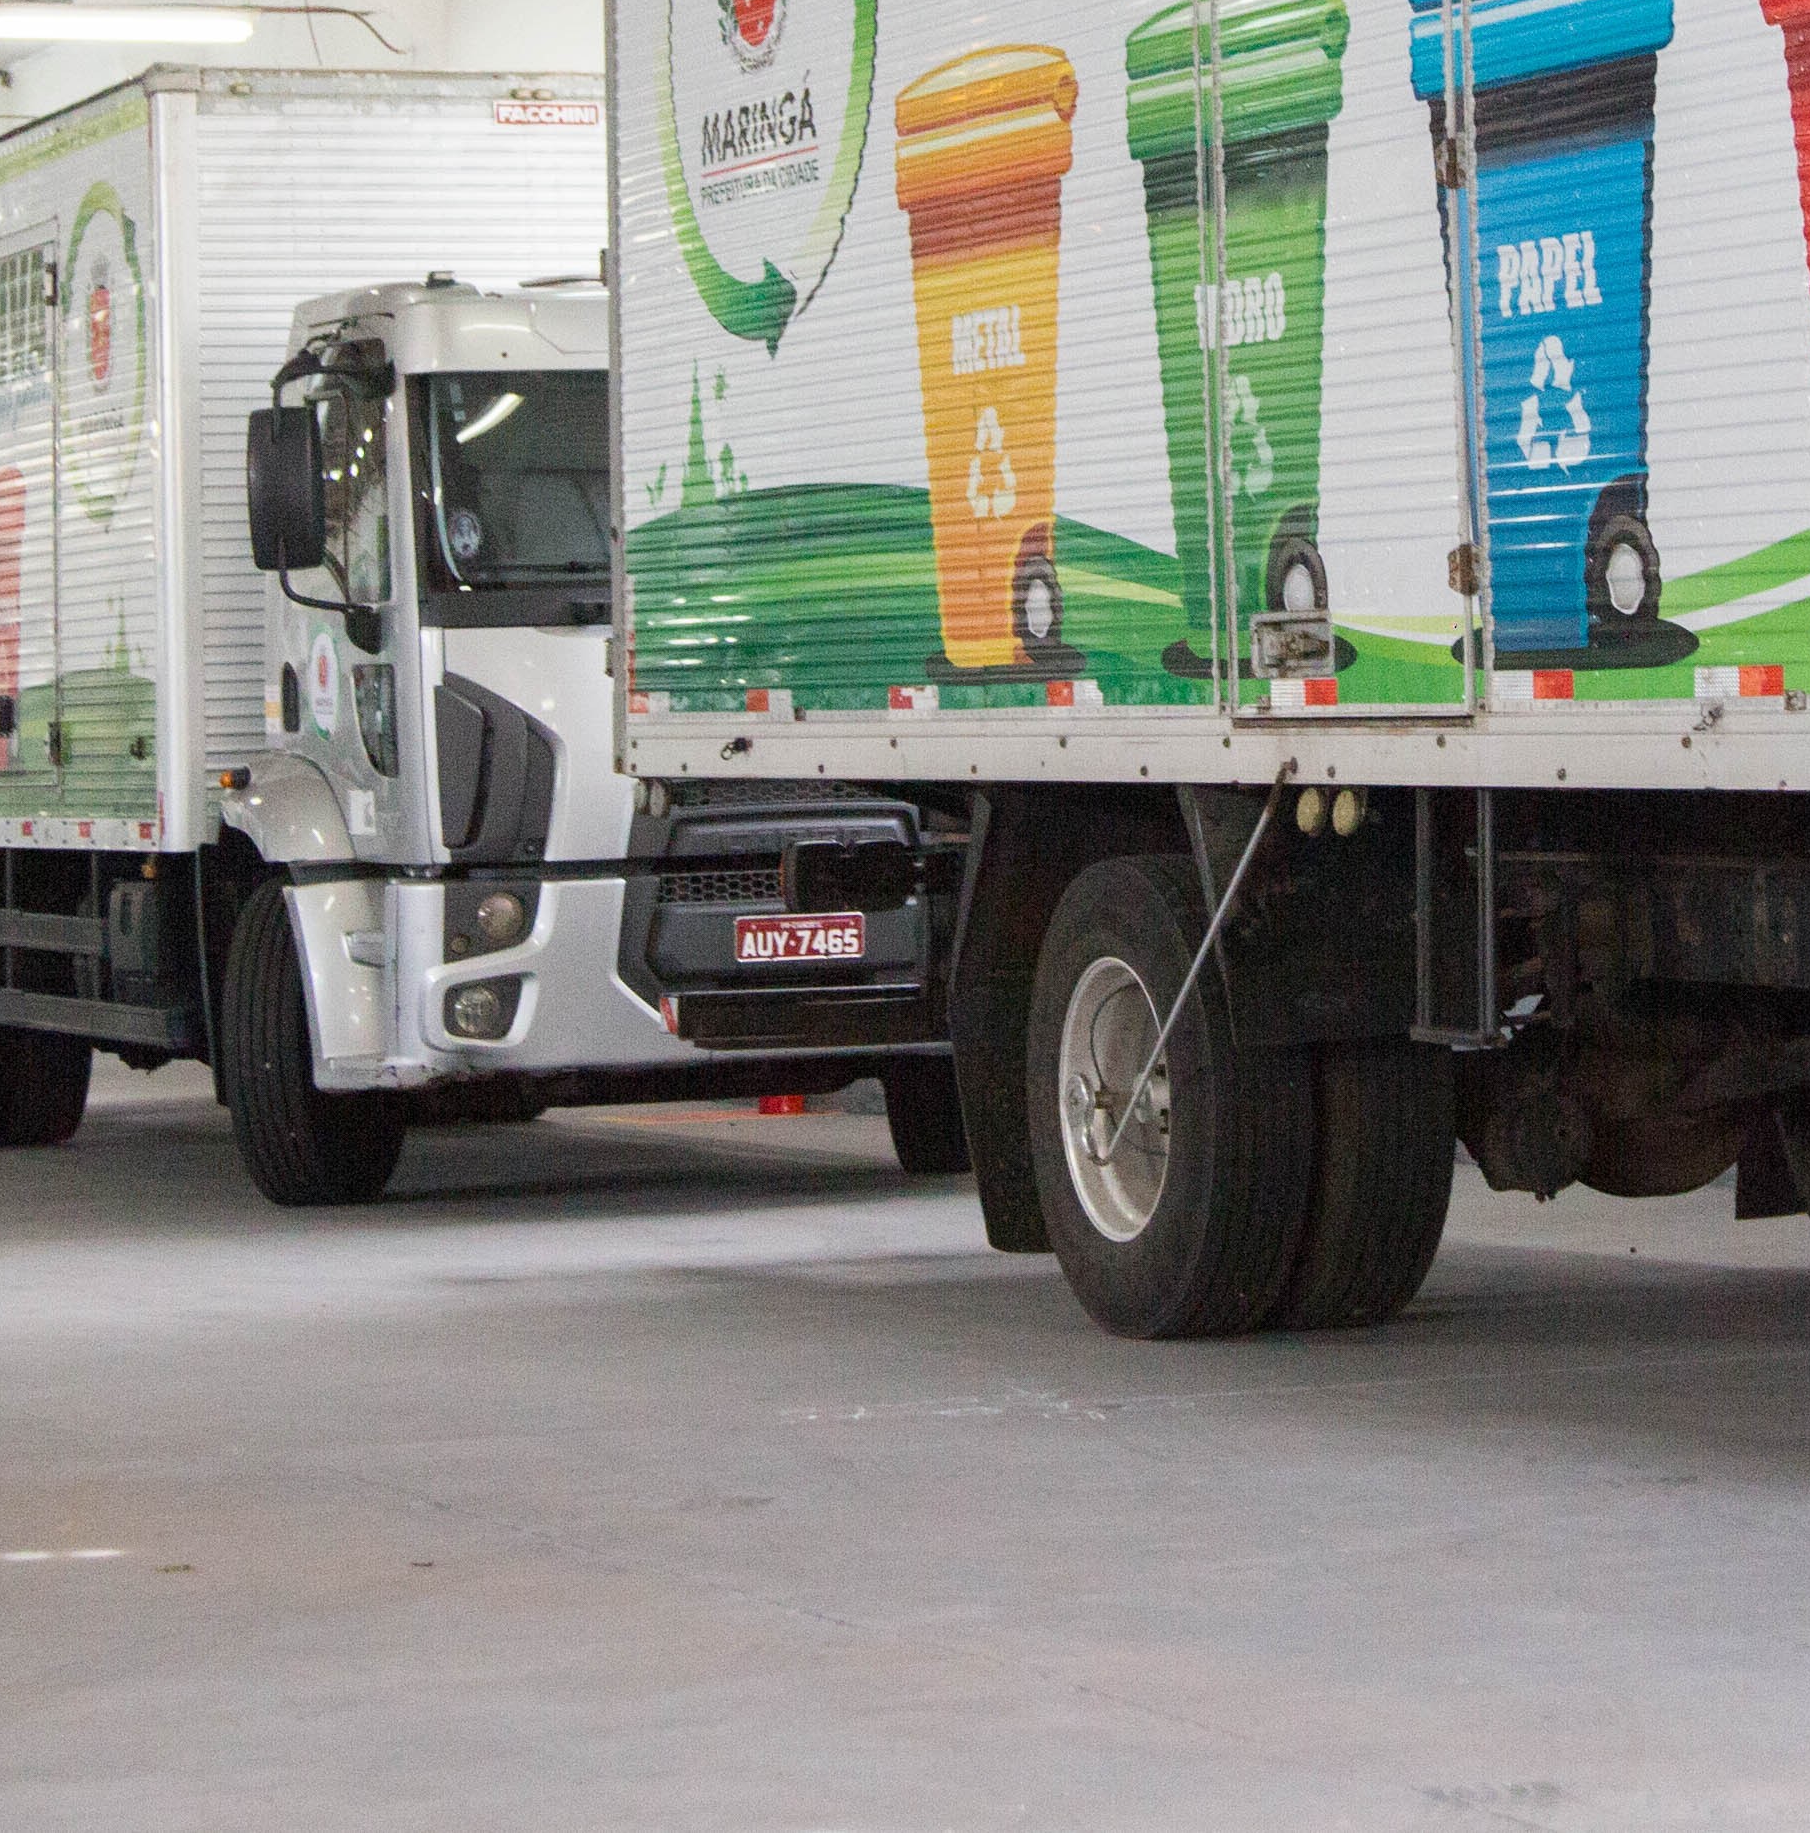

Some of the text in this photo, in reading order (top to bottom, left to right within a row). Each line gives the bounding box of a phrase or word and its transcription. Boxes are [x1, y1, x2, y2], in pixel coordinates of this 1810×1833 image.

[496, 105, 597, 125] FACCHINI
[701, 69, 817, 167] MARINGÁ
[1497, 230, 1603, 318] PAPEL
